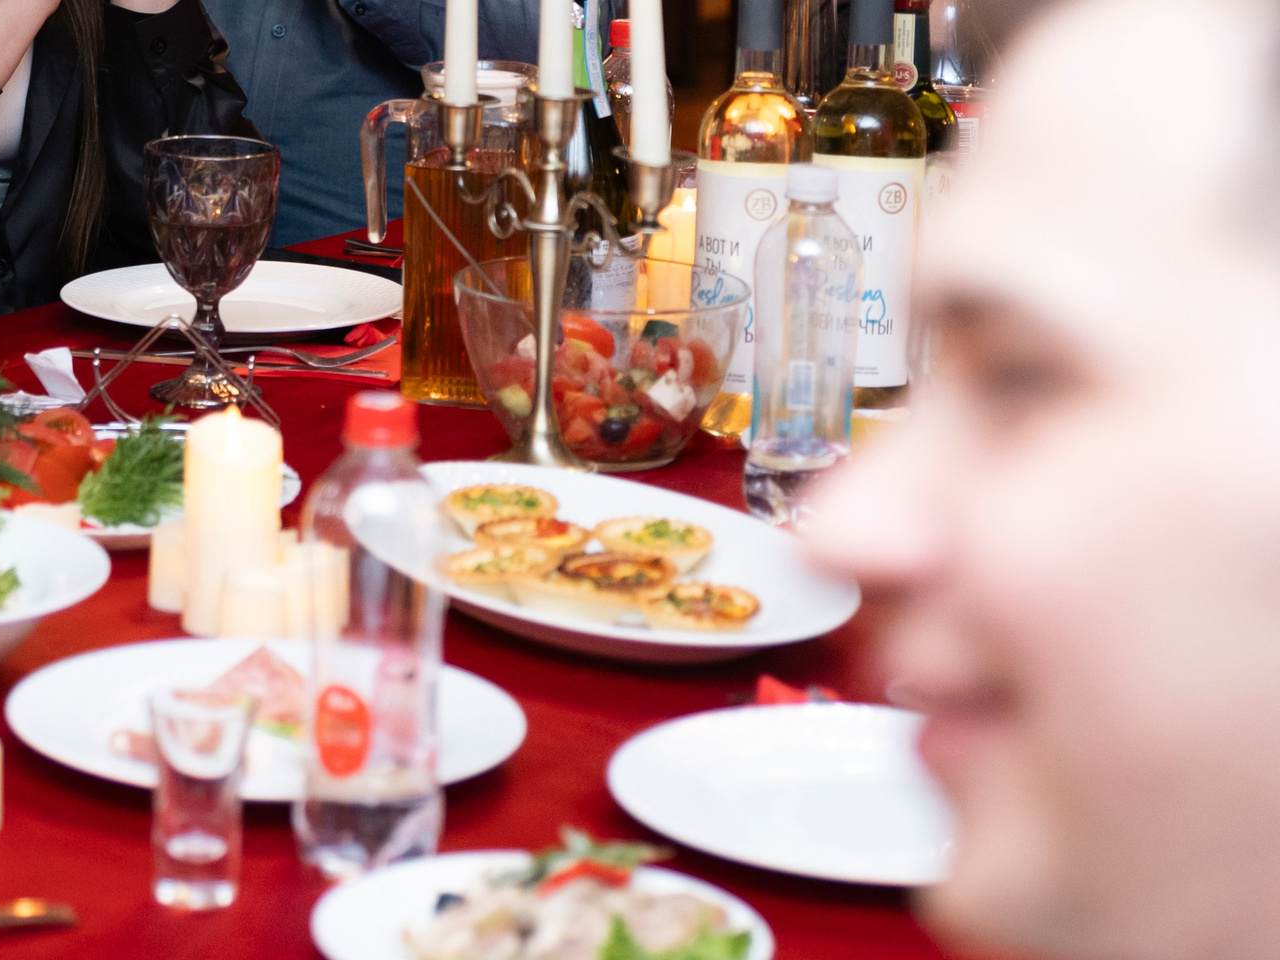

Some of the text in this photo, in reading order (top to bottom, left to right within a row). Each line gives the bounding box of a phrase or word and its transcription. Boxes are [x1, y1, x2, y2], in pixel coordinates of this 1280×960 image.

[753, 197, 771, 211] ZB
[885, 190, 902, 204] ZB
[706, 236, 726, 256] ВОТ
[730, 241, 740, 257] И
[863, 235, 873, 252] И
